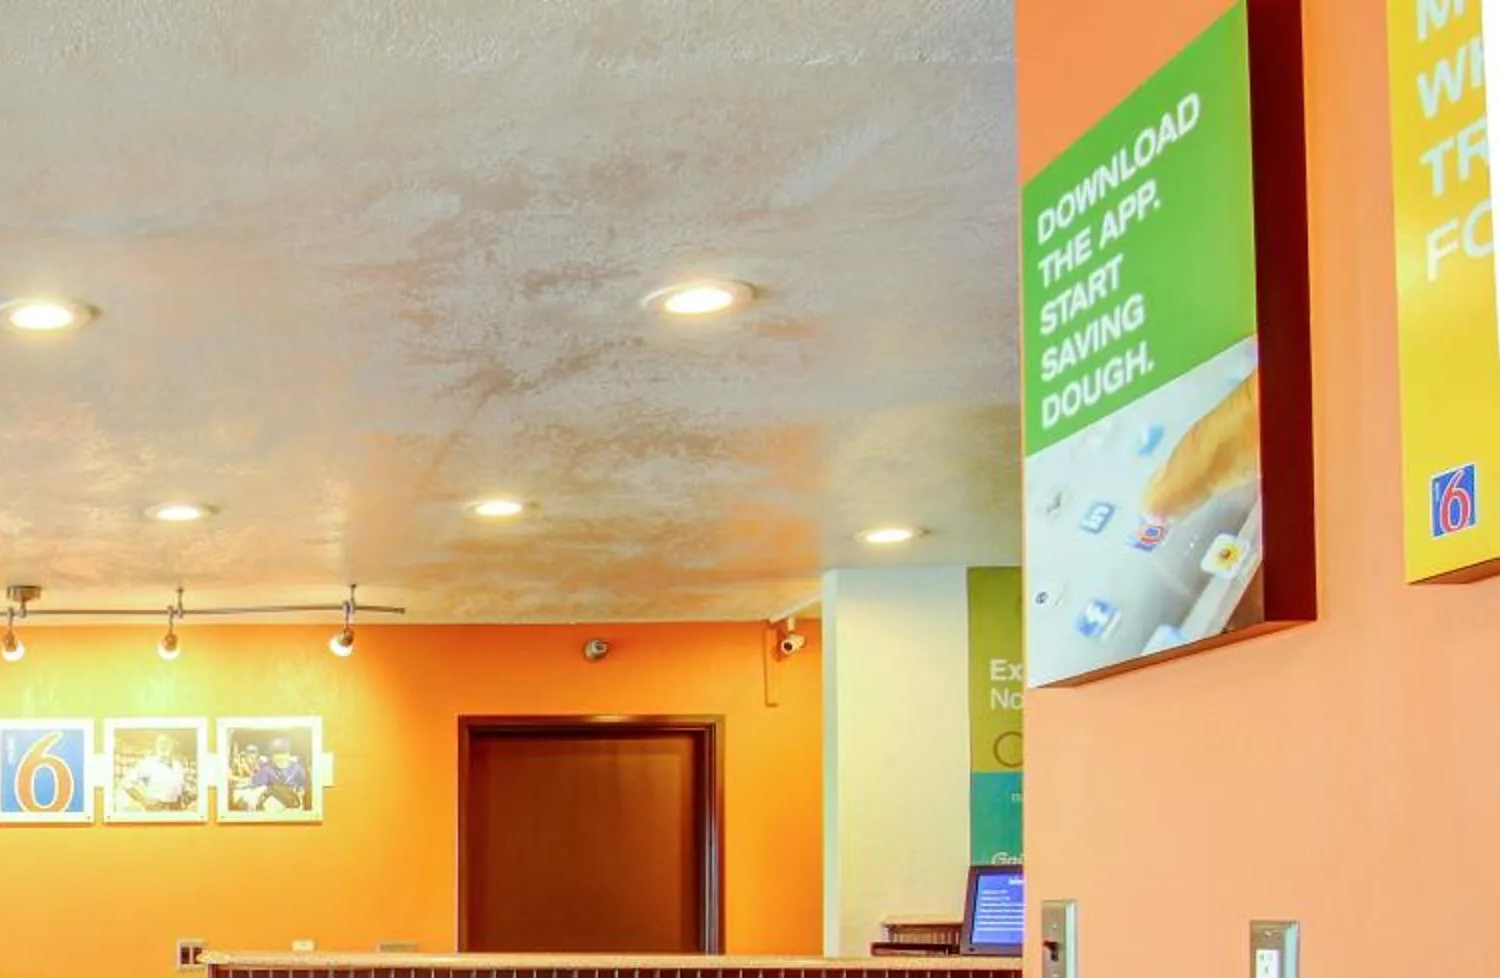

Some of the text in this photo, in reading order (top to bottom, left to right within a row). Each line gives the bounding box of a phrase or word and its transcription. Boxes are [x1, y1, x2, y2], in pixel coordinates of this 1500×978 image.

[1037, 92, 1201, 246] DOWNLOAD
[1037, 179, 1161, 288] THE APP.
[1040, 253, 1124, 335] START
[1041, 293, 1146, 382] SAVING
[1042, 341, 1155, 430] DOUGH.
[1440, 469, 1472, 535] 6
[13, 730, 74, 813] 6
